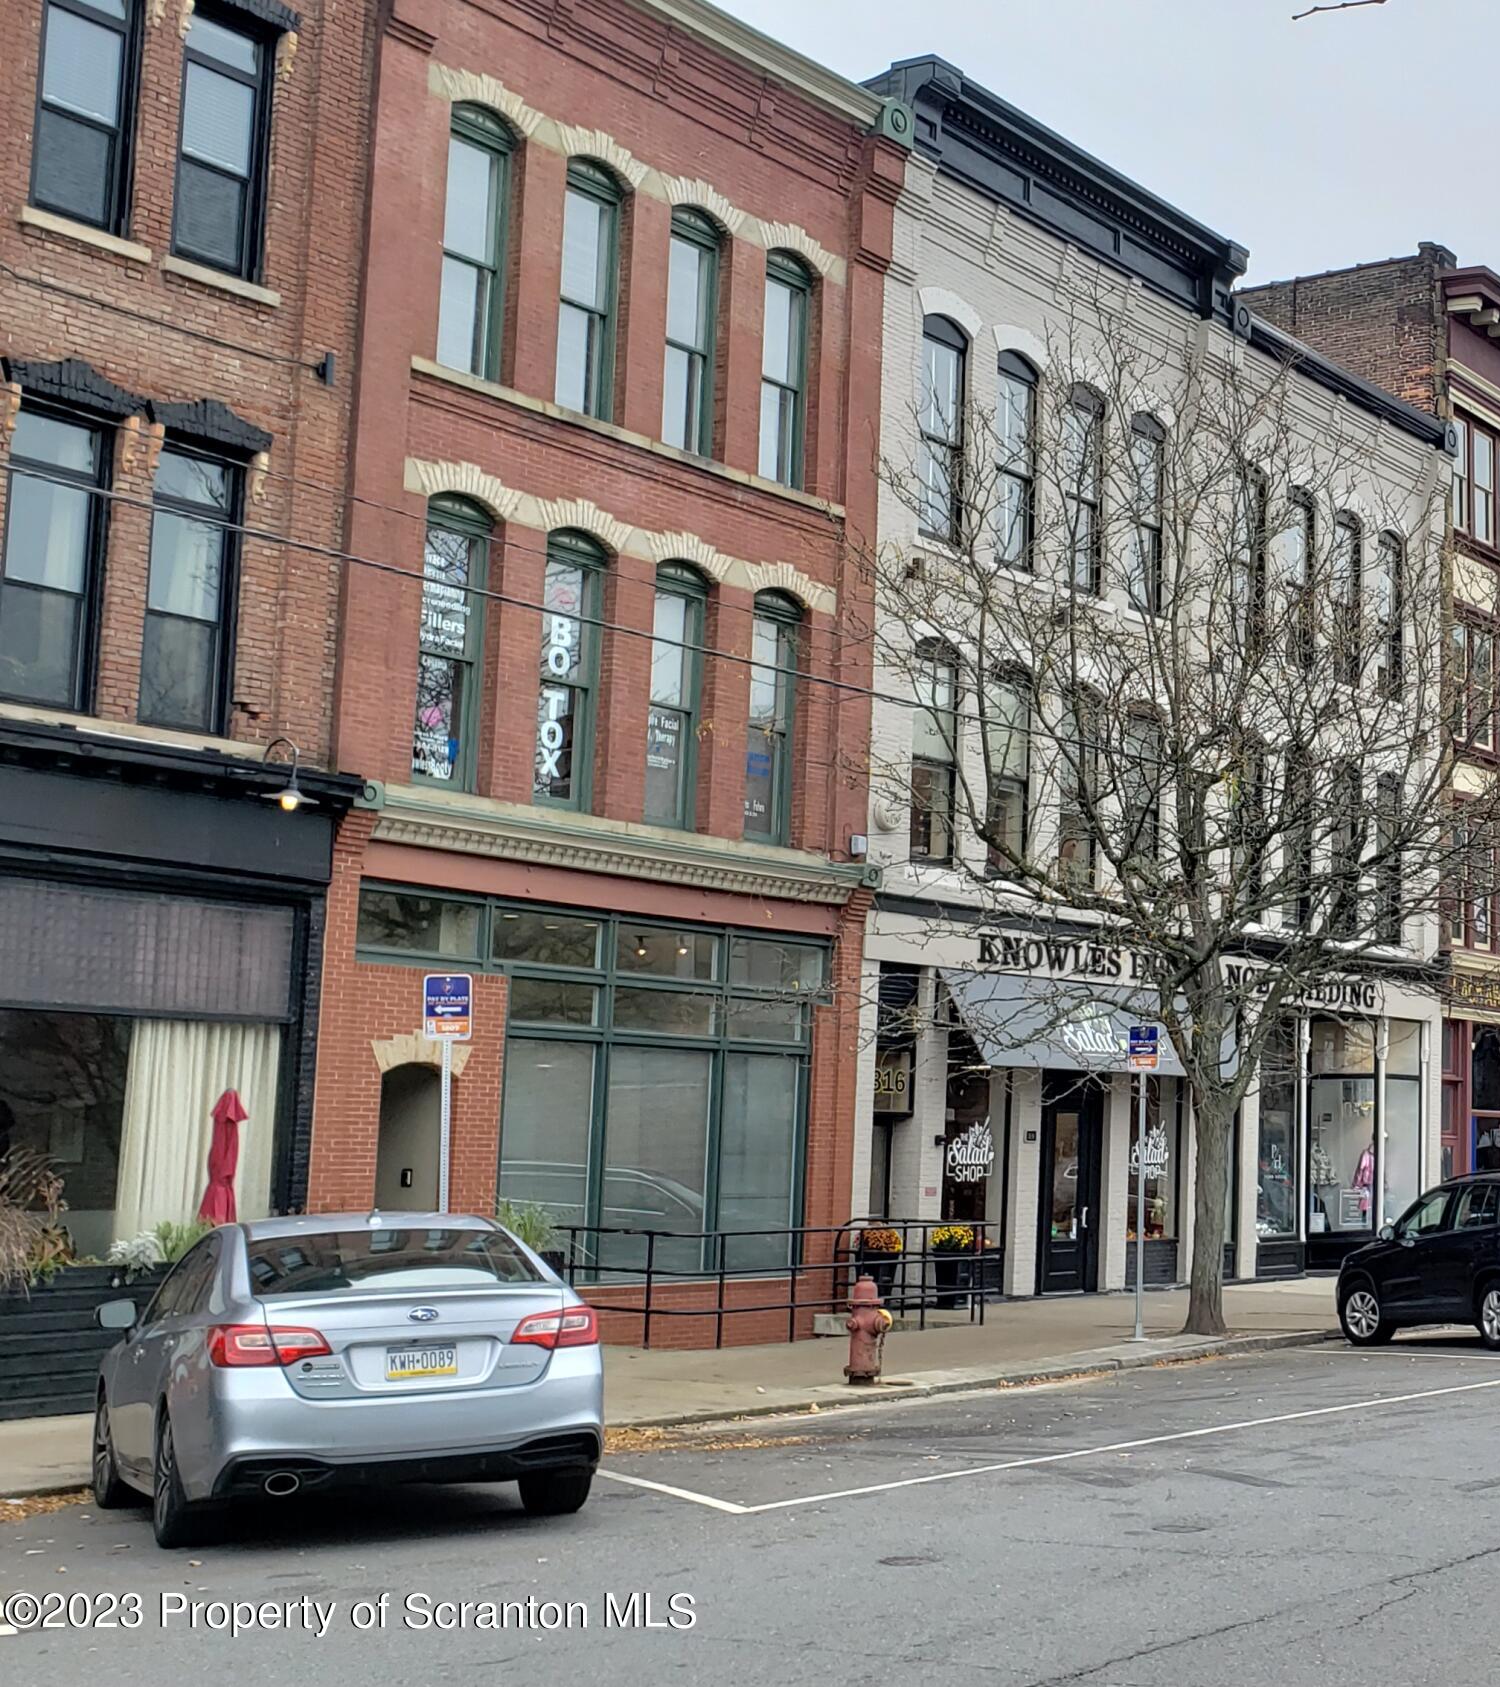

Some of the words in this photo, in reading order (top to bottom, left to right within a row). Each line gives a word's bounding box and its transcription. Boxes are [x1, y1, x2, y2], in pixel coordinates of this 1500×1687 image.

[977, 933, 1122, 977] KNOWLES
[949, 1136, 991, 1166] Salad
[954, 1165, 984, 1182] SHOP
